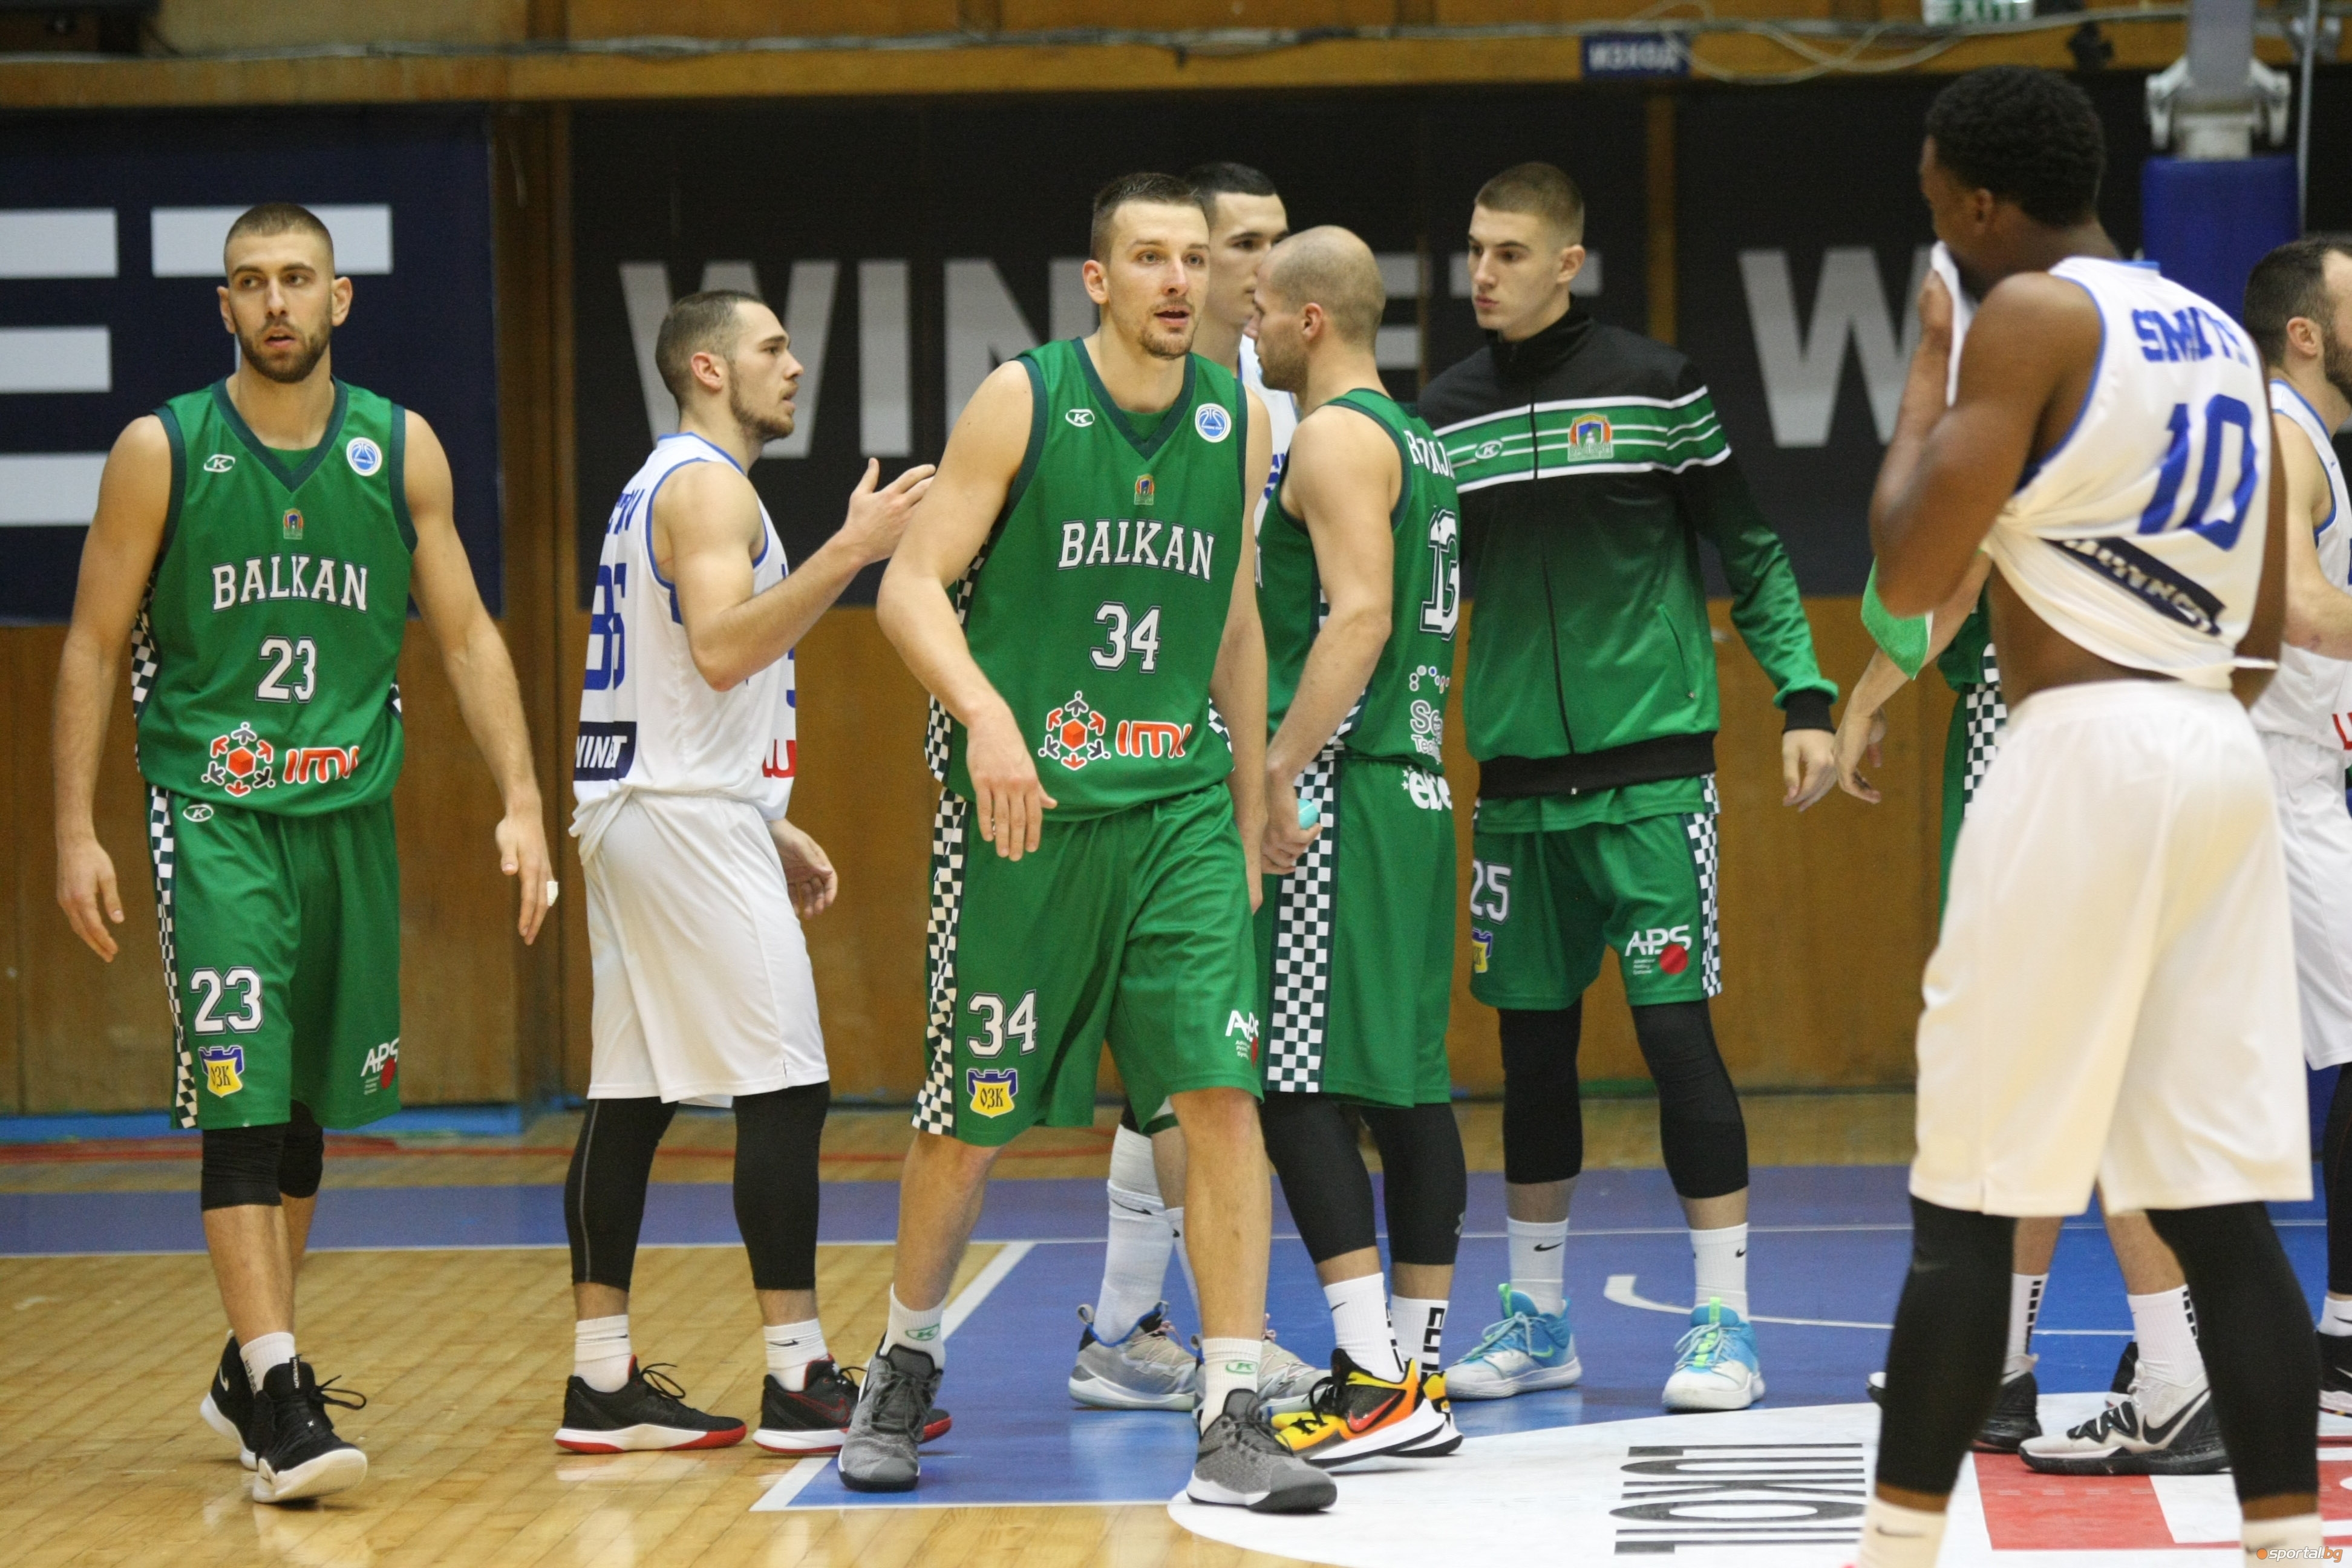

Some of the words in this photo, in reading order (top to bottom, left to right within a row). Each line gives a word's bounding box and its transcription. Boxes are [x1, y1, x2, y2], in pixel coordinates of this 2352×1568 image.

[2137, 394, 2259, 552] 10
[211, 553, 368, 614] BALKAN
[1057, 518, 1215, 583] BALKAN
[255, 635, 318, 704] 23
[1089, 601, 1161, 673] 34
[1470, 858, 1512, 925] 25
[1625, 924, 1692, 956] APS
[189, 966, 264, 1036] 23
[967, 988, 1038, 1059] 34
